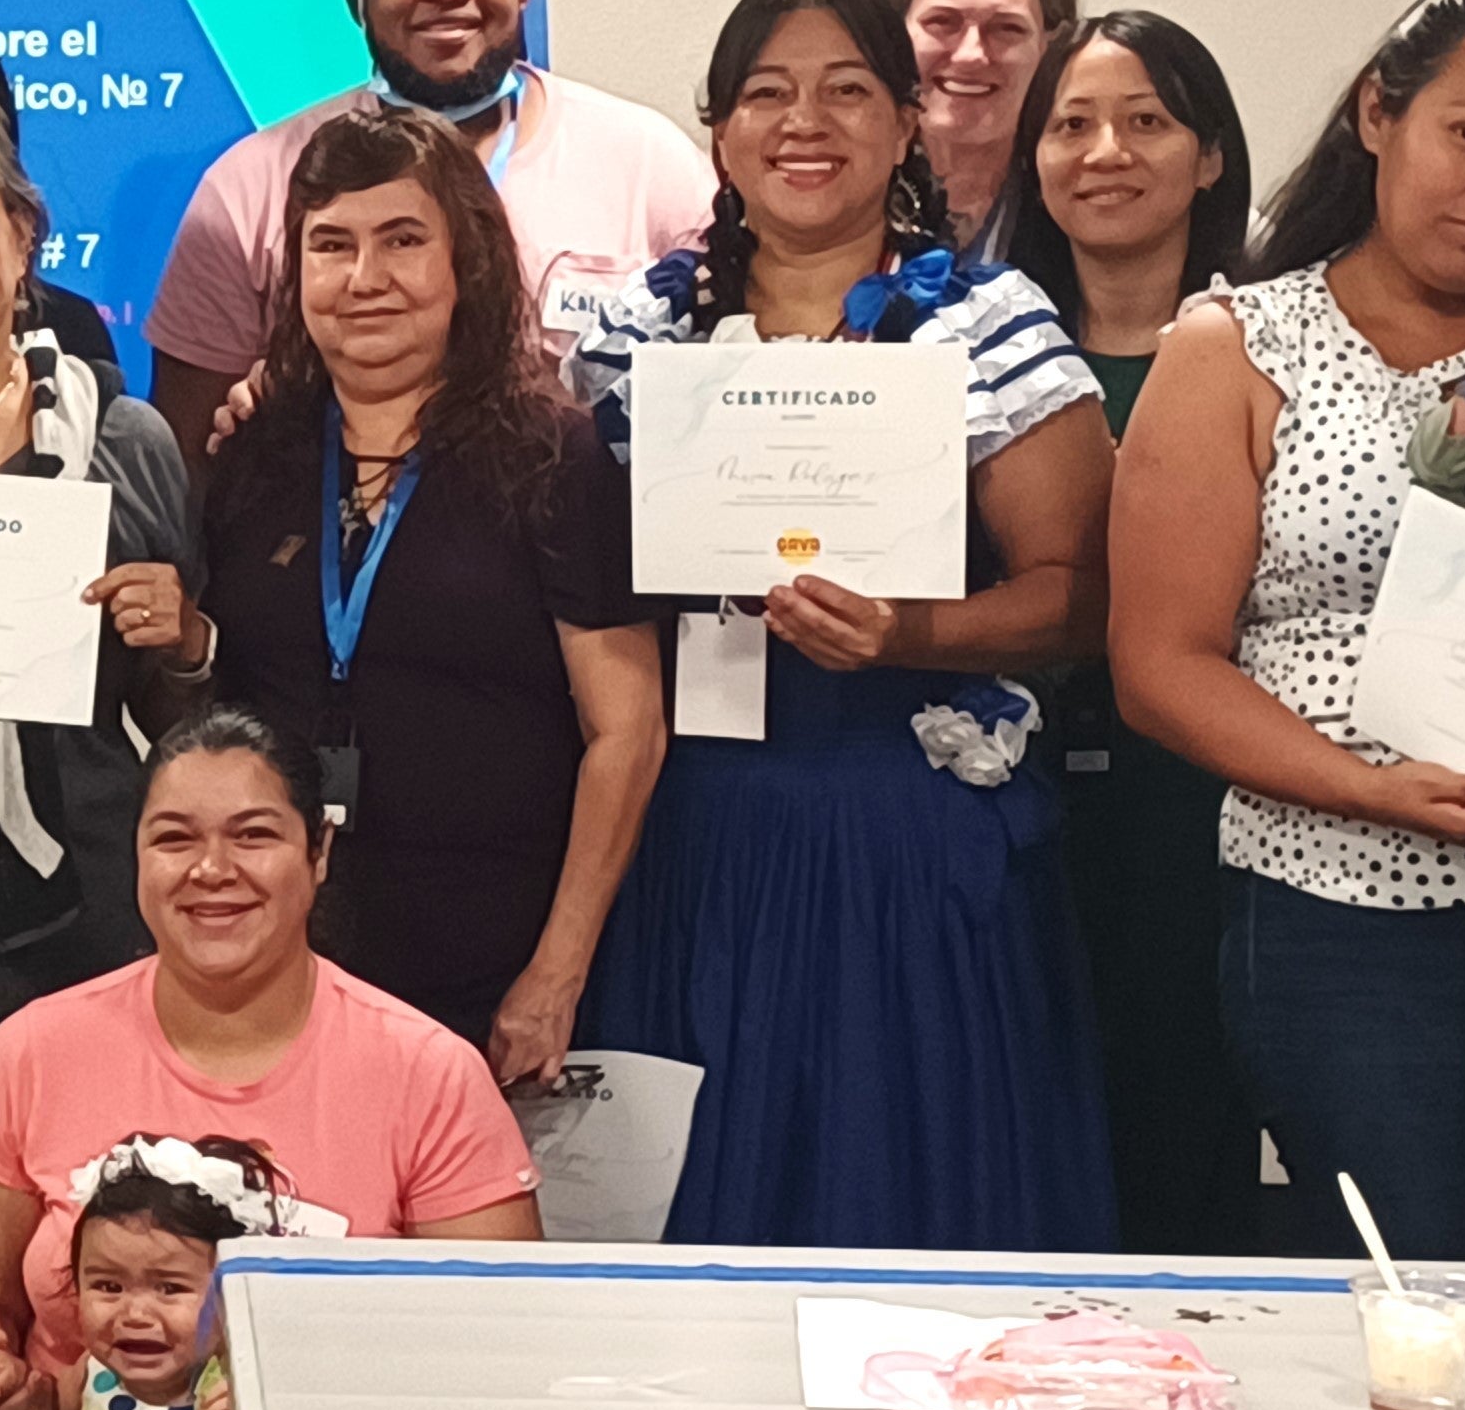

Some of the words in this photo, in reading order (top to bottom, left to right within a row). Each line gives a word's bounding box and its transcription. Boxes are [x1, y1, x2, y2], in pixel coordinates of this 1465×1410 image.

[60, 20, 97, 58] el
[159, 72, 184, 109] 7
[75, 233, 100, 269] 7
[721, 390, 877, 406] CERTIFICADO
